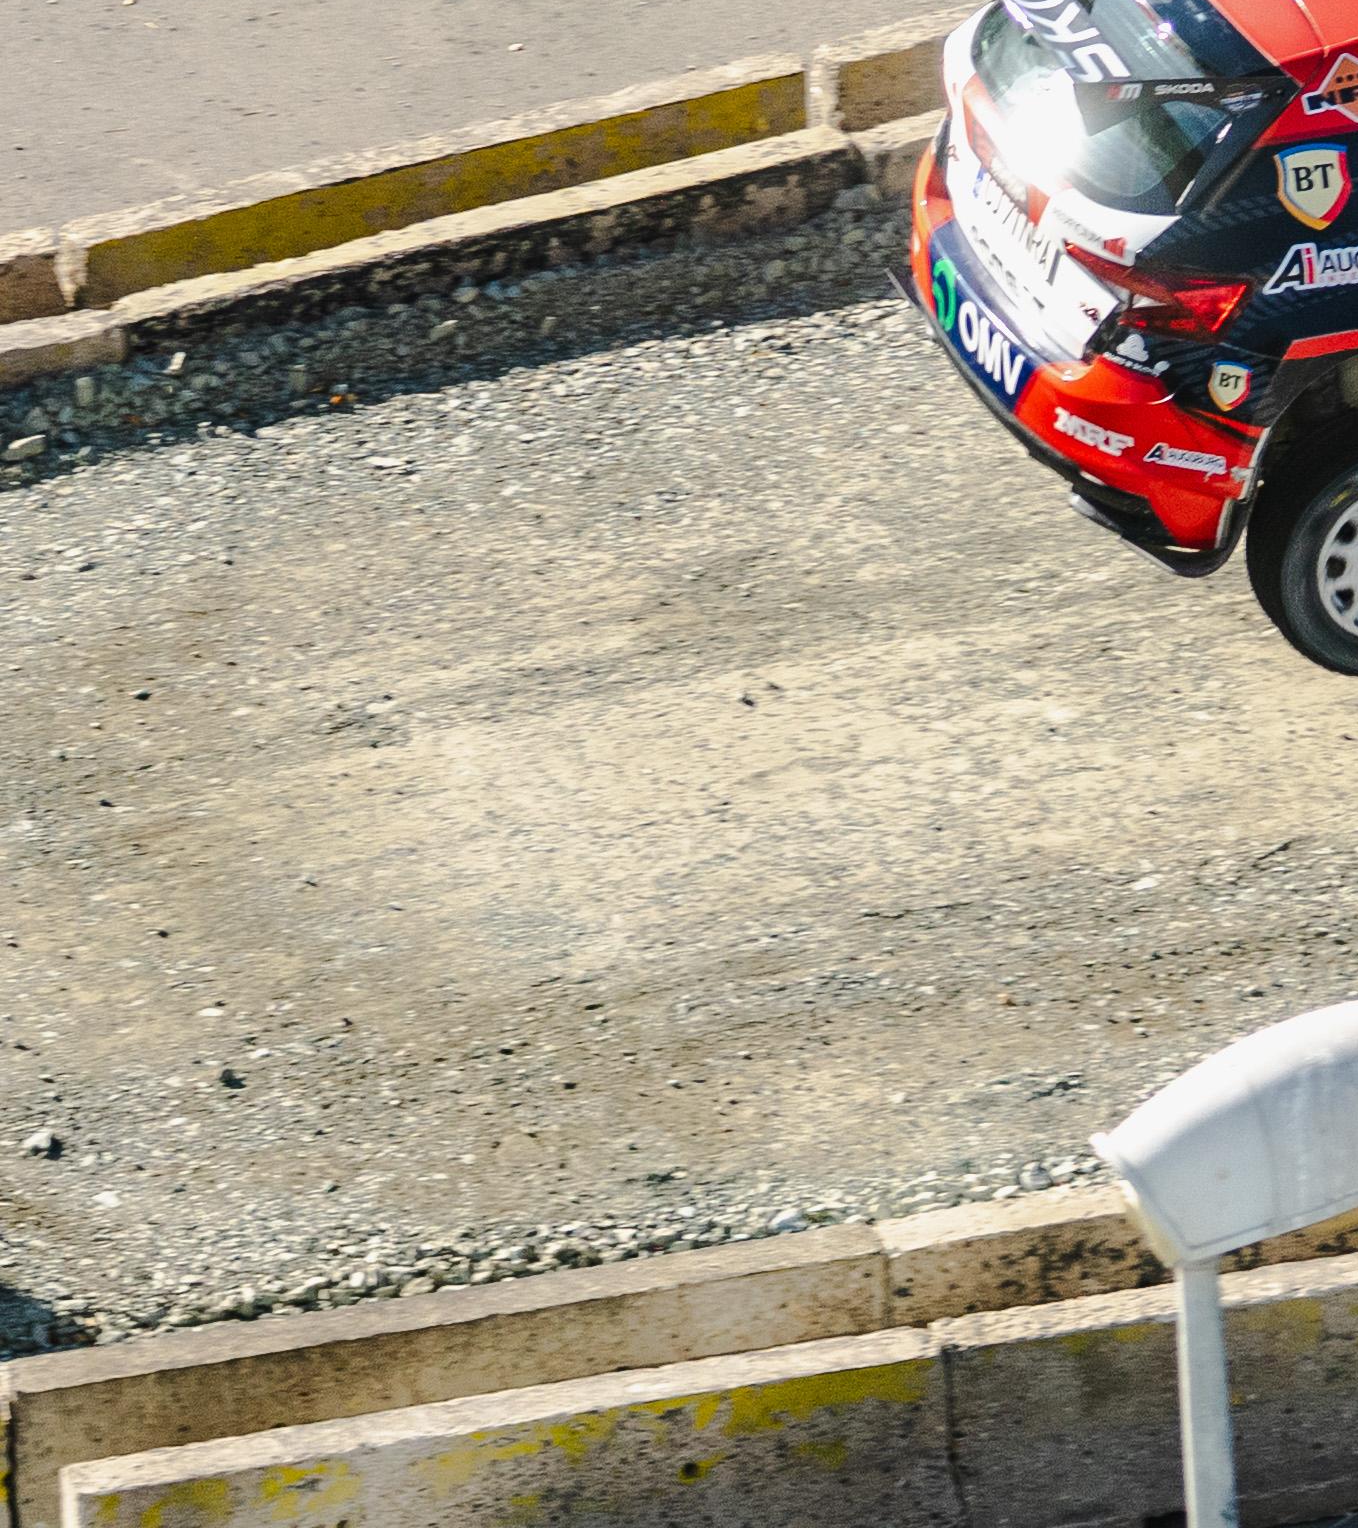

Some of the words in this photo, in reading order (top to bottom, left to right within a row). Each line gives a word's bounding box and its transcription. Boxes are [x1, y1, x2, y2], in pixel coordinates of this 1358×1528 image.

[1154, 73, 1215, 95] SKODA
[1293, 162, 1335, 194] BT
[958, 301, 1024, 396] OMV
[1218, 372, 1241, 389] BT
